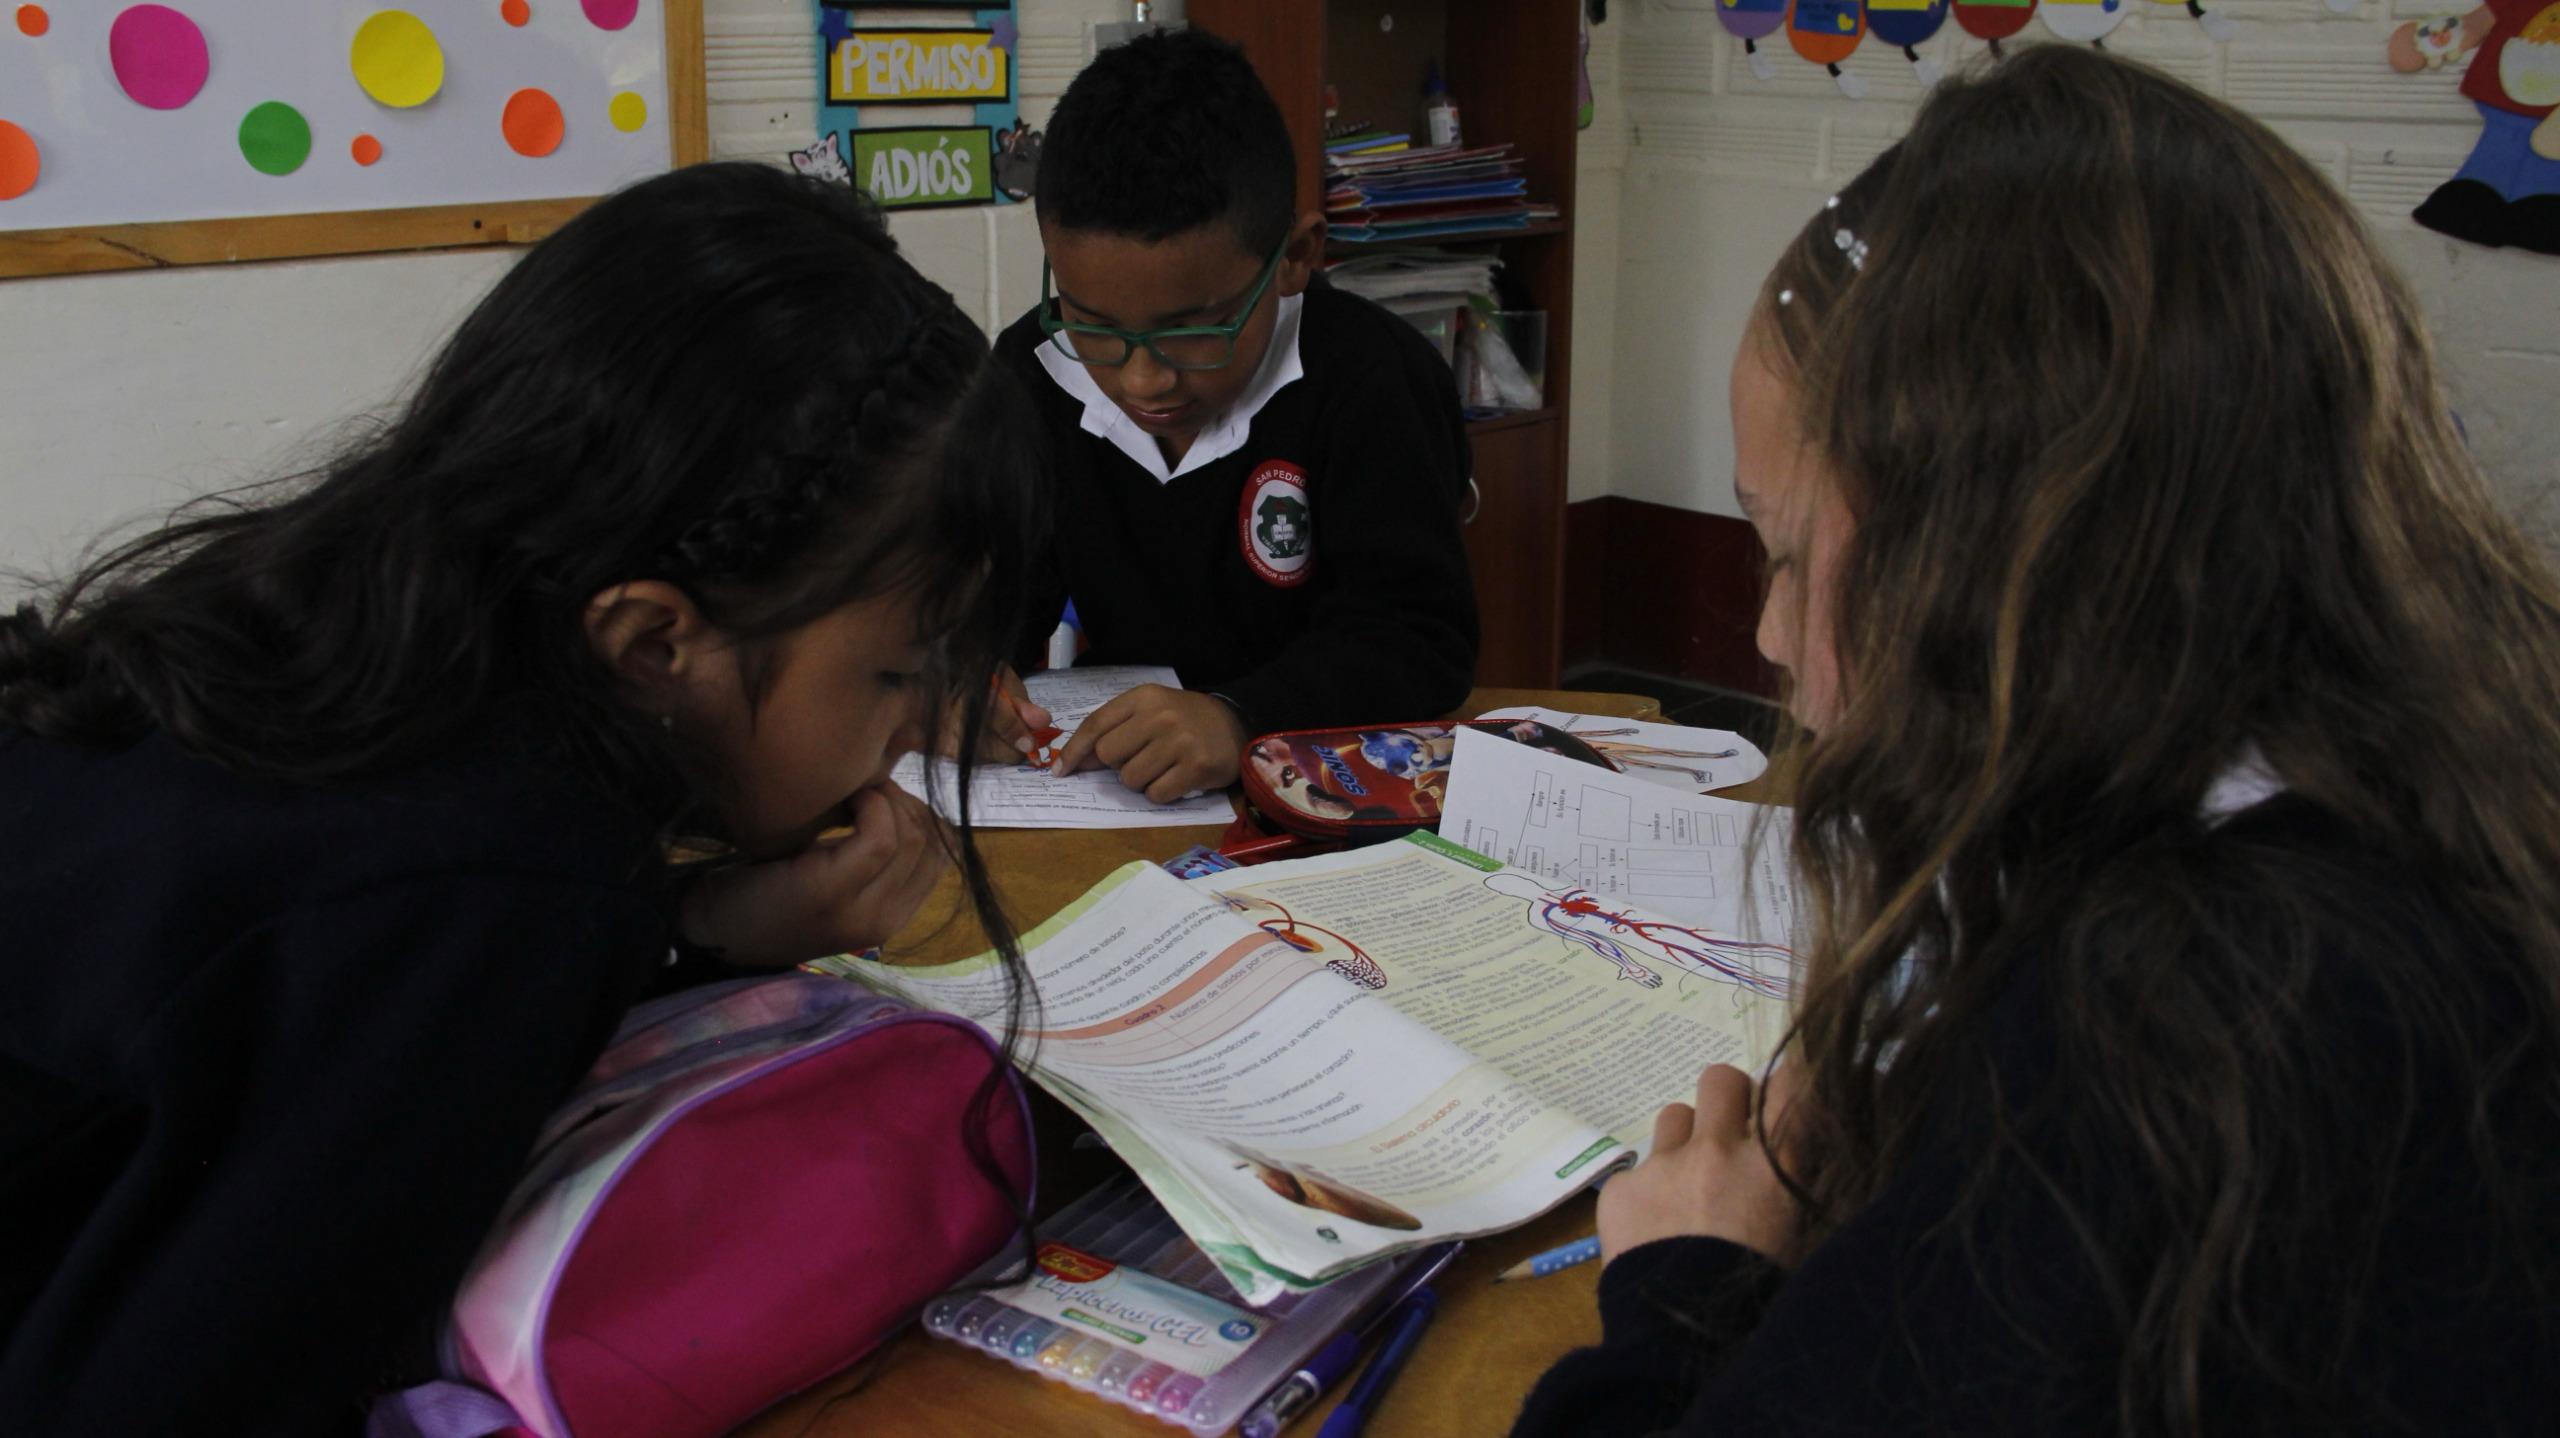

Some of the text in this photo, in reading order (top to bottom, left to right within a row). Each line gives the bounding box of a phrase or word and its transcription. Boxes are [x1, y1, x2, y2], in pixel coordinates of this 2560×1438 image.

[843, 39, 995, 95] PERMISO
[871, 136, 972, 199] ADIÓS
[1256, 469, 1305, 487] SAN PEDRO
[1312, 744, 1367, 799] SONIC
[1122, 956, 1135, 967] del
[1152, 922, 1182, 946] durante
[1158, 933, 1184, 954] cuenta
[1169, 995, 1208, 1022] Número
[1205, 988, 1218, 999] de
[1216, 966, 1247, 991] latidos
[1245, 955, 1261, 969] por
[1259, 1043, 1289, 1065] durante
[1288, 1036, 1299, 1046] un
[1321, 1047, 1355, 1076] corazón?
[1151, 1314, 1210, 1348] GEL
[1230, 1320, 1252, 1337] 10
